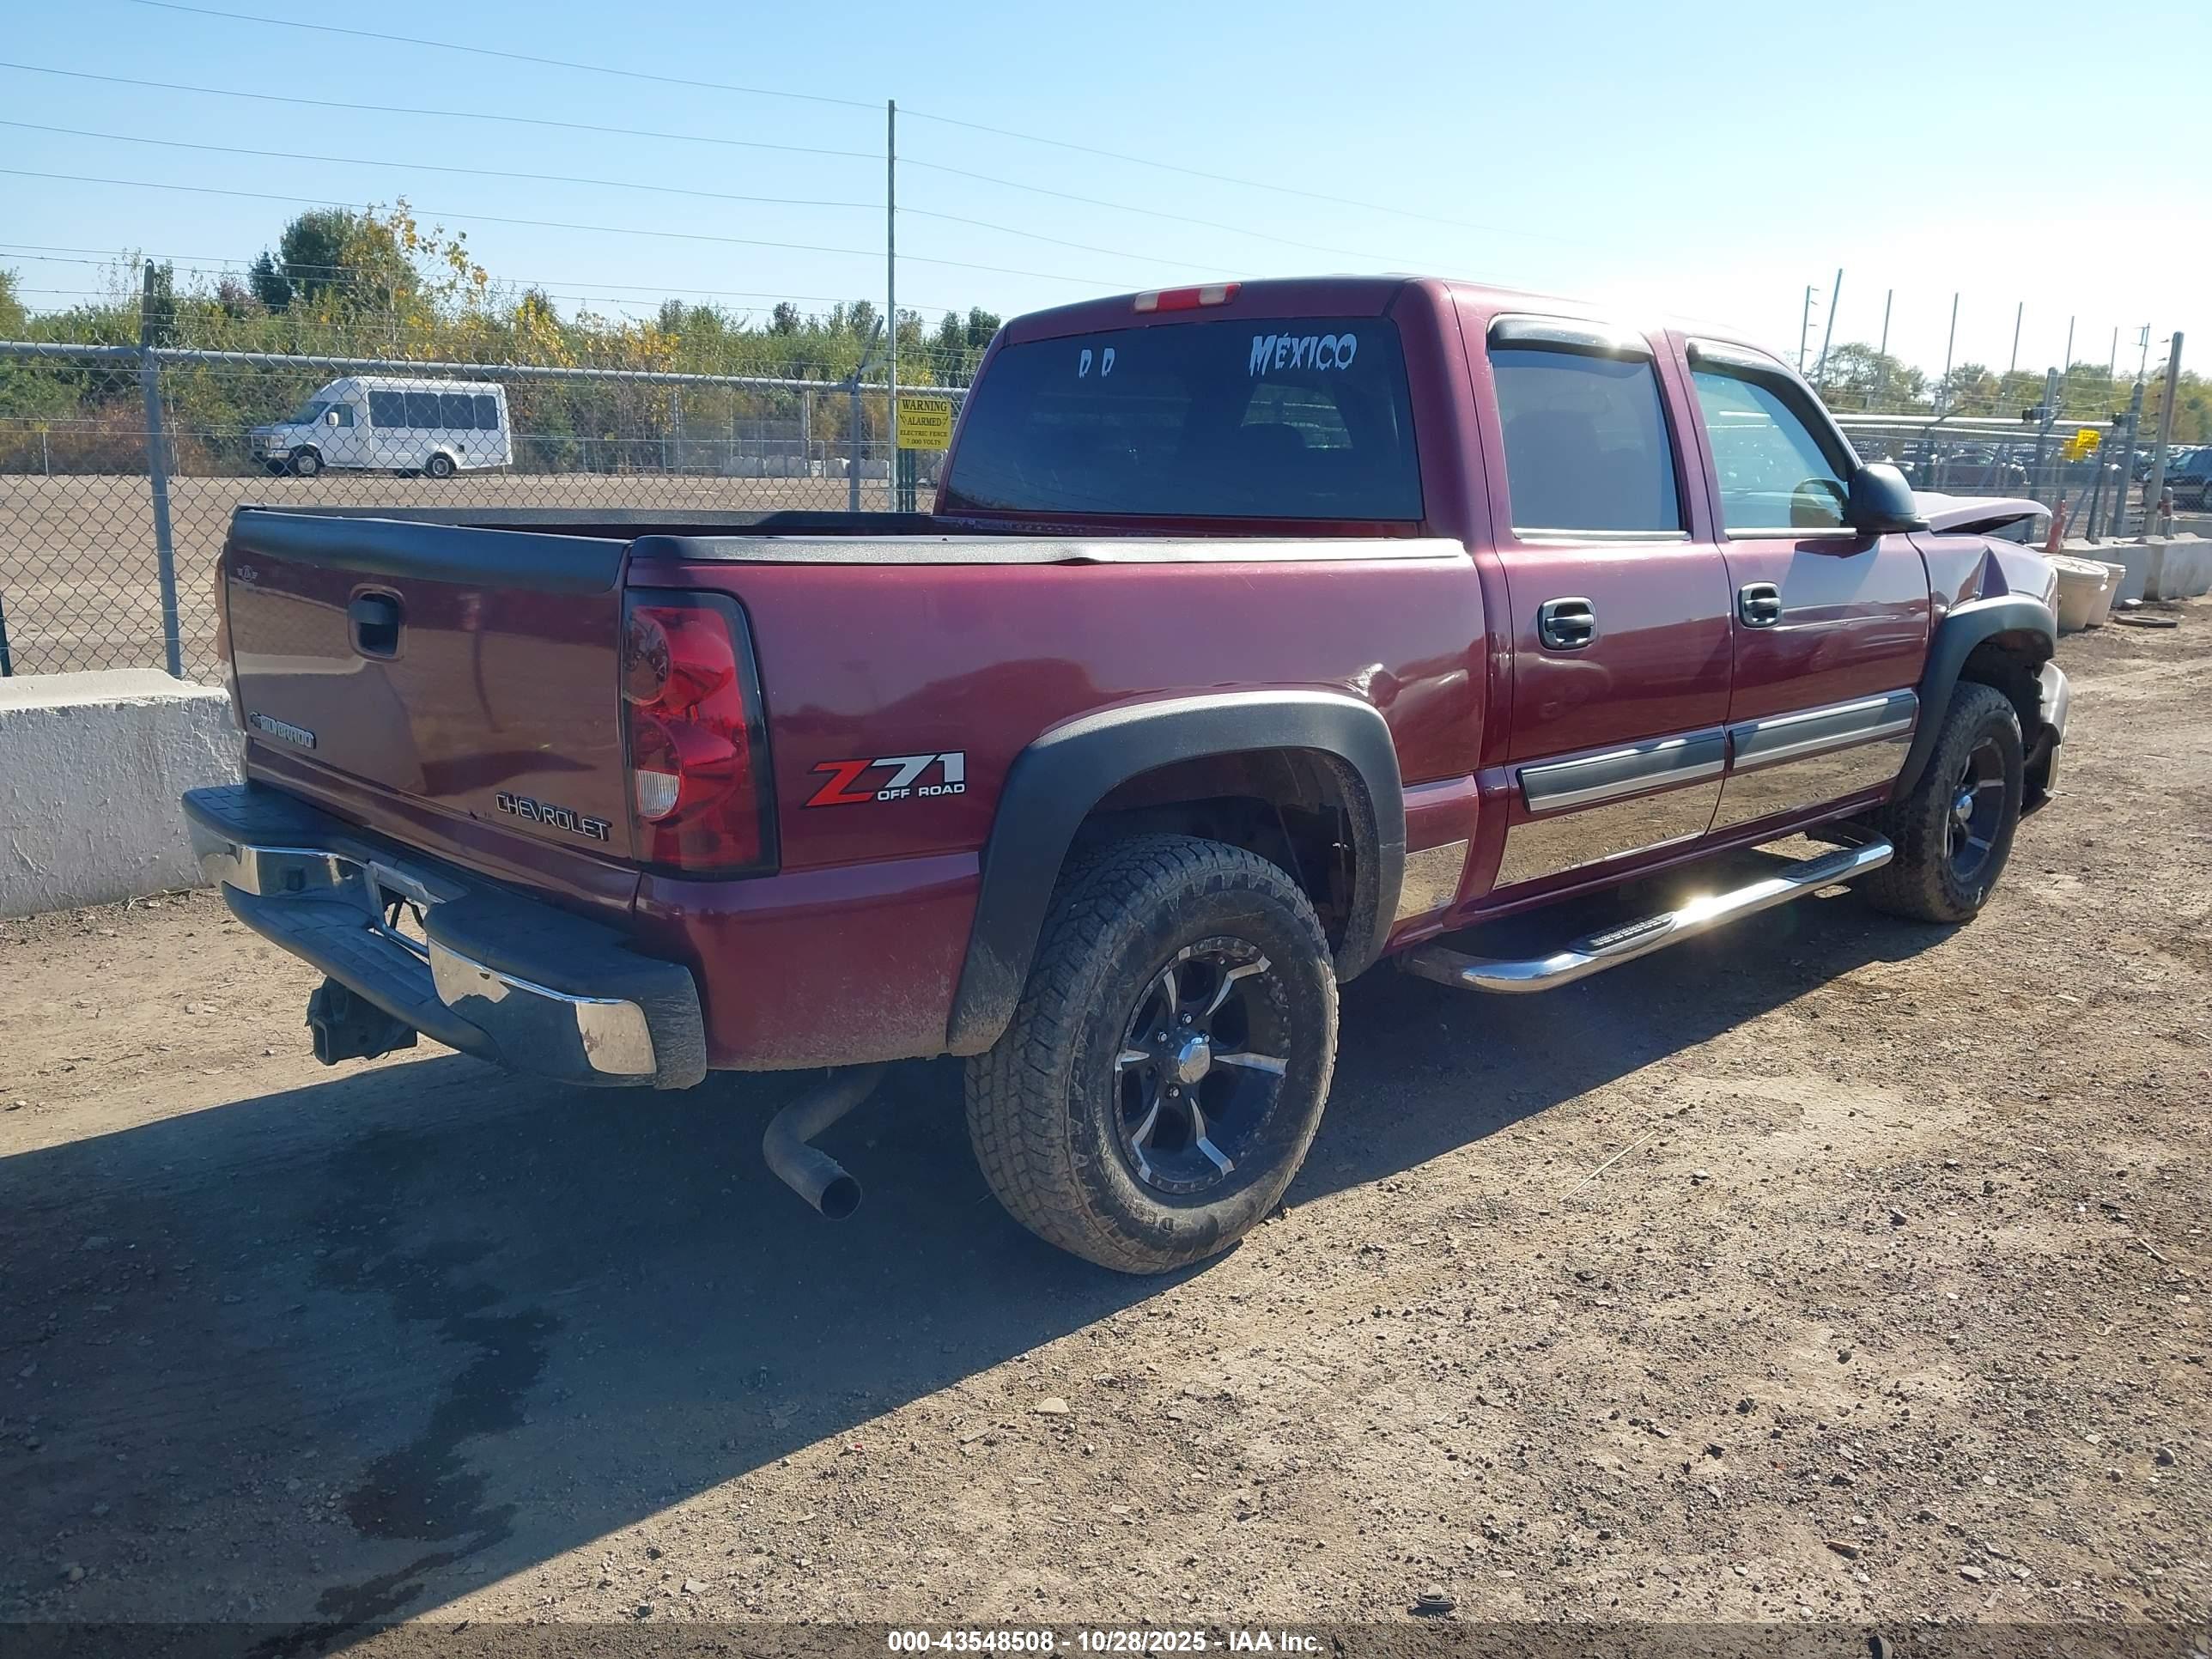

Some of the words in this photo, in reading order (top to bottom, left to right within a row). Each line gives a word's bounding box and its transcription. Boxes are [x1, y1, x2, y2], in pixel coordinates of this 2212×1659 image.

[1079, 349, 1092, 378] D
[1101, 348, 1115, 377] D
[1249, 332, 1358, 377] MÉXICO
[902, 399, 947, 412] WARNING
[907, 416, 942, 427] ALARMED
[805, 751, 964, 807] Z71
[877, 788, 910, 800] OFF
[918, 783, 966, 797] ROAD
[495, 792, 611, 841] CHEVROLET
